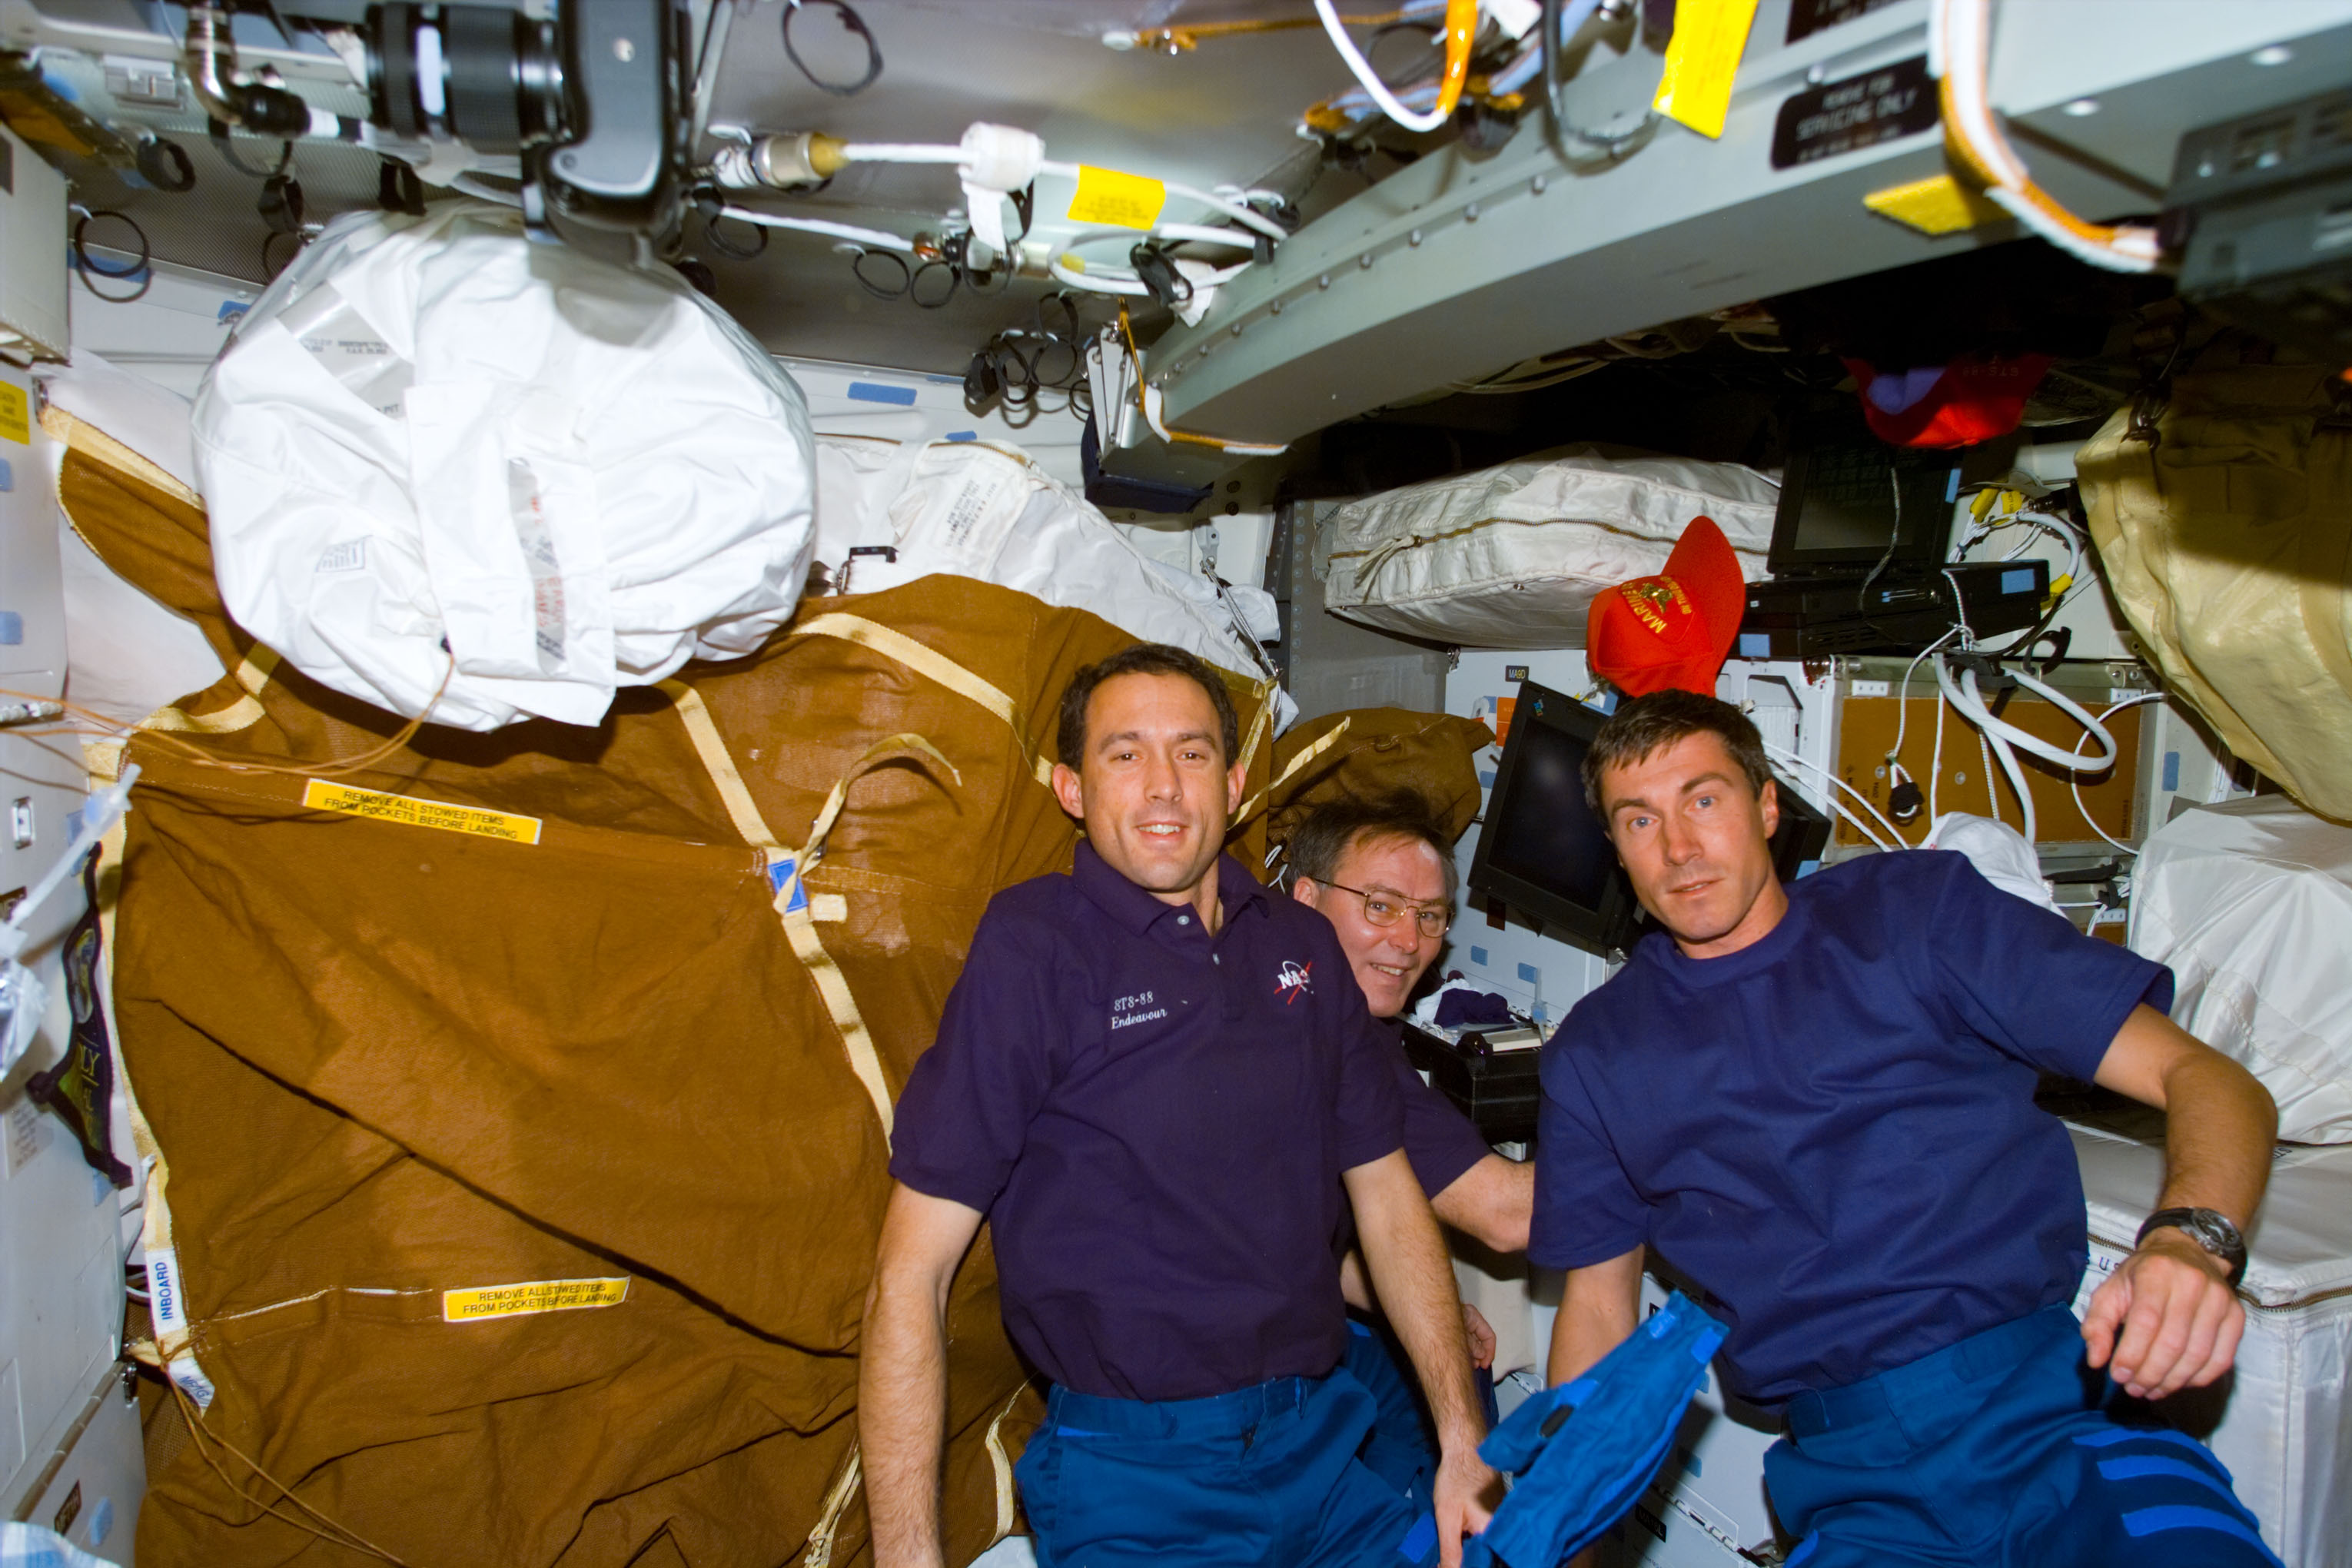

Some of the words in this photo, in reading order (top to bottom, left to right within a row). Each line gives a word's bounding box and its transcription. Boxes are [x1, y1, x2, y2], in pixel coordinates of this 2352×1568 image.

[324, 798, 359, 811] FROM
[361, 805, 416, 821] POCKETS
[419, 815, 466, 829] BEFORE
[467, 822, 518, 839] LANDING
[344, 790, 393, 806] REMOVE
[396, 799, 416, 810] ALL
[420, 805, 468, 820] STOWED
[470, 813, 505, 826] ITEMS
[1115, 991, 1153, 1012] STS-88
[1111, 1008, 1168, 1029] Endeavour
[155, 1262, 173, 1320] INBOARD
[479, 1289, 525, 1301] REMOVE
[528, 1287, 546, 1297] ALL
[463, 1300, 494, 1314] FROM
[498, 1297, 546, 1311] POCKETS
[580, 1293, 616, 1304] LANDING
